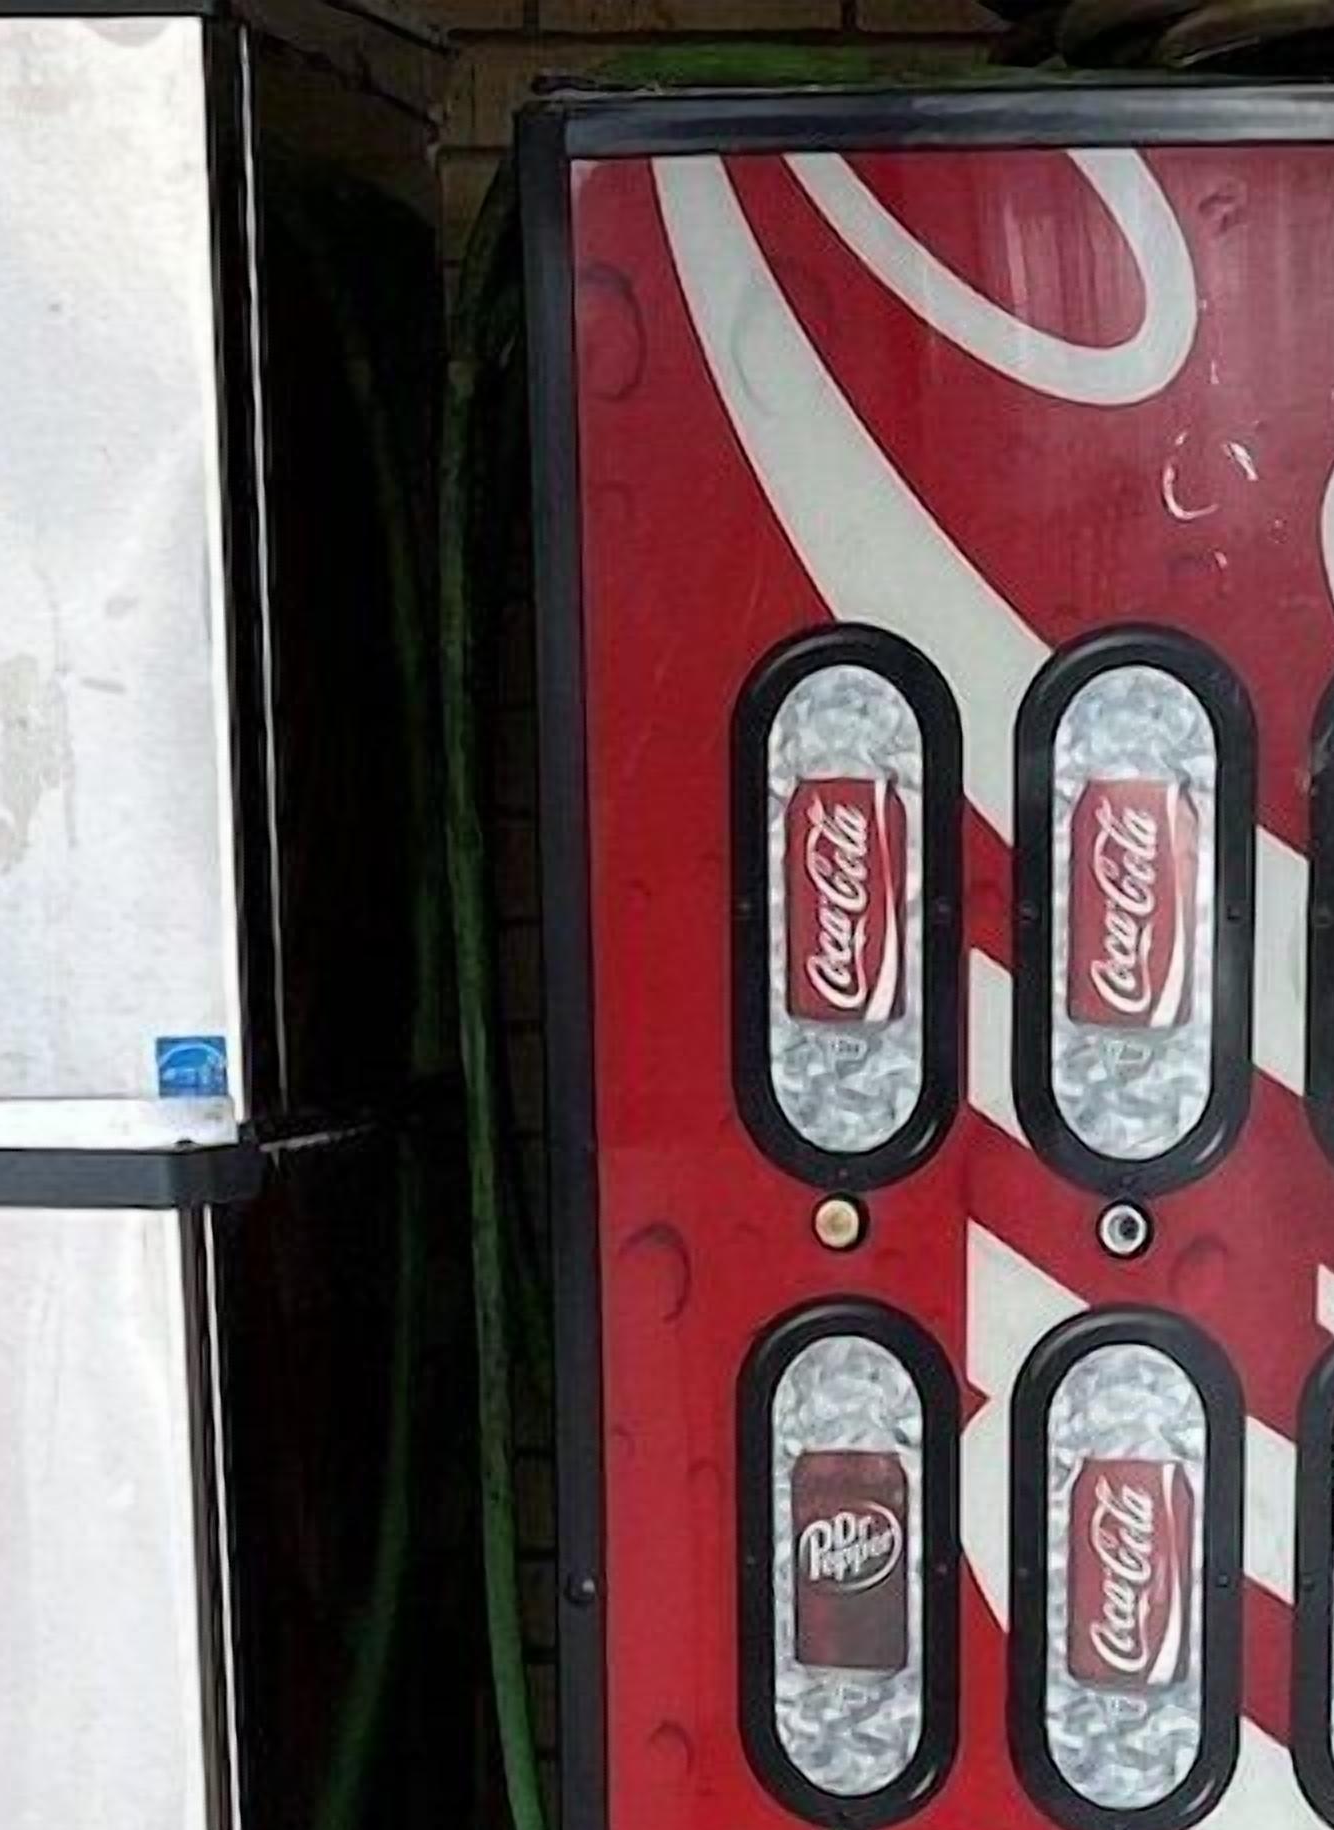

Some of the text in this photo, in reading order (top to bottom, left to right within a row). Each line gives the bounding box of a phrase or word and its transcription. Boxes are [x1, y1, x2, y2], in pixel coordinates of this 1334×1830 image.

[807, 796, 868, 1009] Coca-Cola
[1090, 797, 1158, 1014] Coca-Cola
[1089, 1474, 1155, 1673] Coca-Cola
